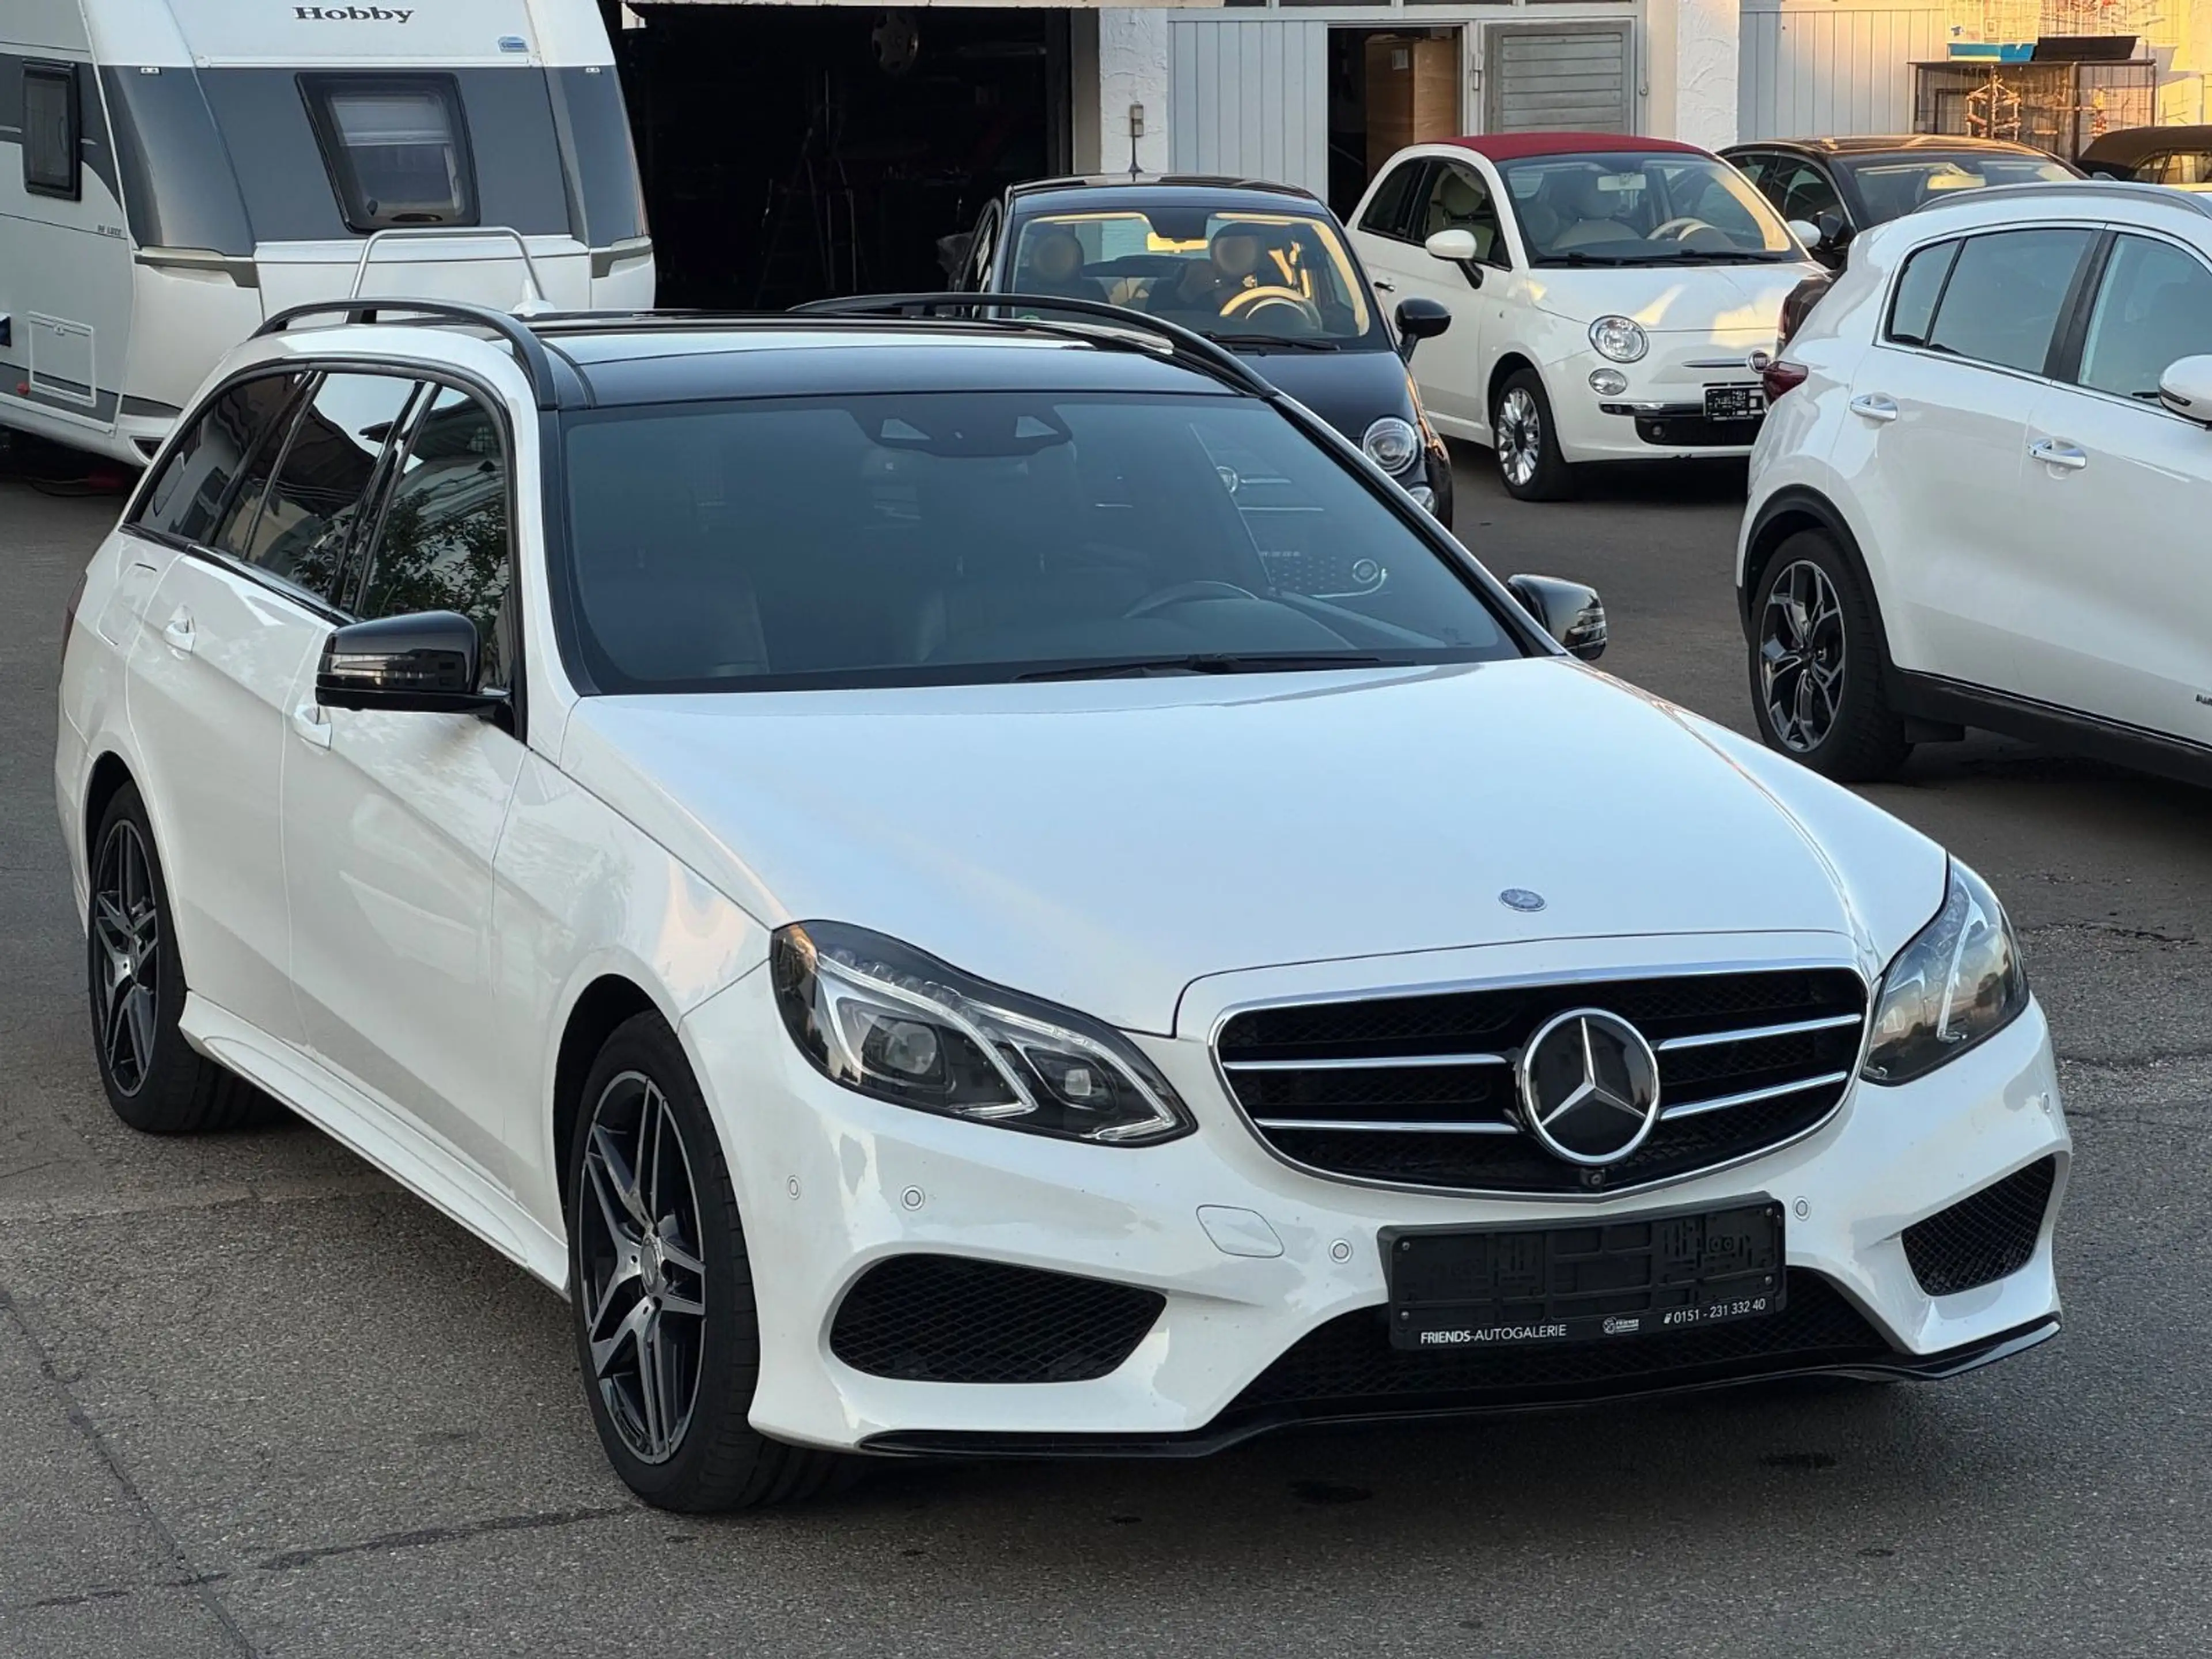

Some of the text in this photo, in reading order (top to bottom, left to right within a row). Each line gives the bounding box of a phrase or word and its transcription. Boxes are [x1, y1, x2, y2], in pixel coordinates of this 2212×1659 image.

[292, 6, 414, 23] Hobby
[1674, 1309, 1699, 1323] 0151
[1709, 1305, 1728, 1318] 231
[1731, 1301, 1750, 1315] 332
[1752, 1298, 1766, 1310] 40
[1421, 1324, 1566, 1344] FRIENDS-AUTOGALERIE
